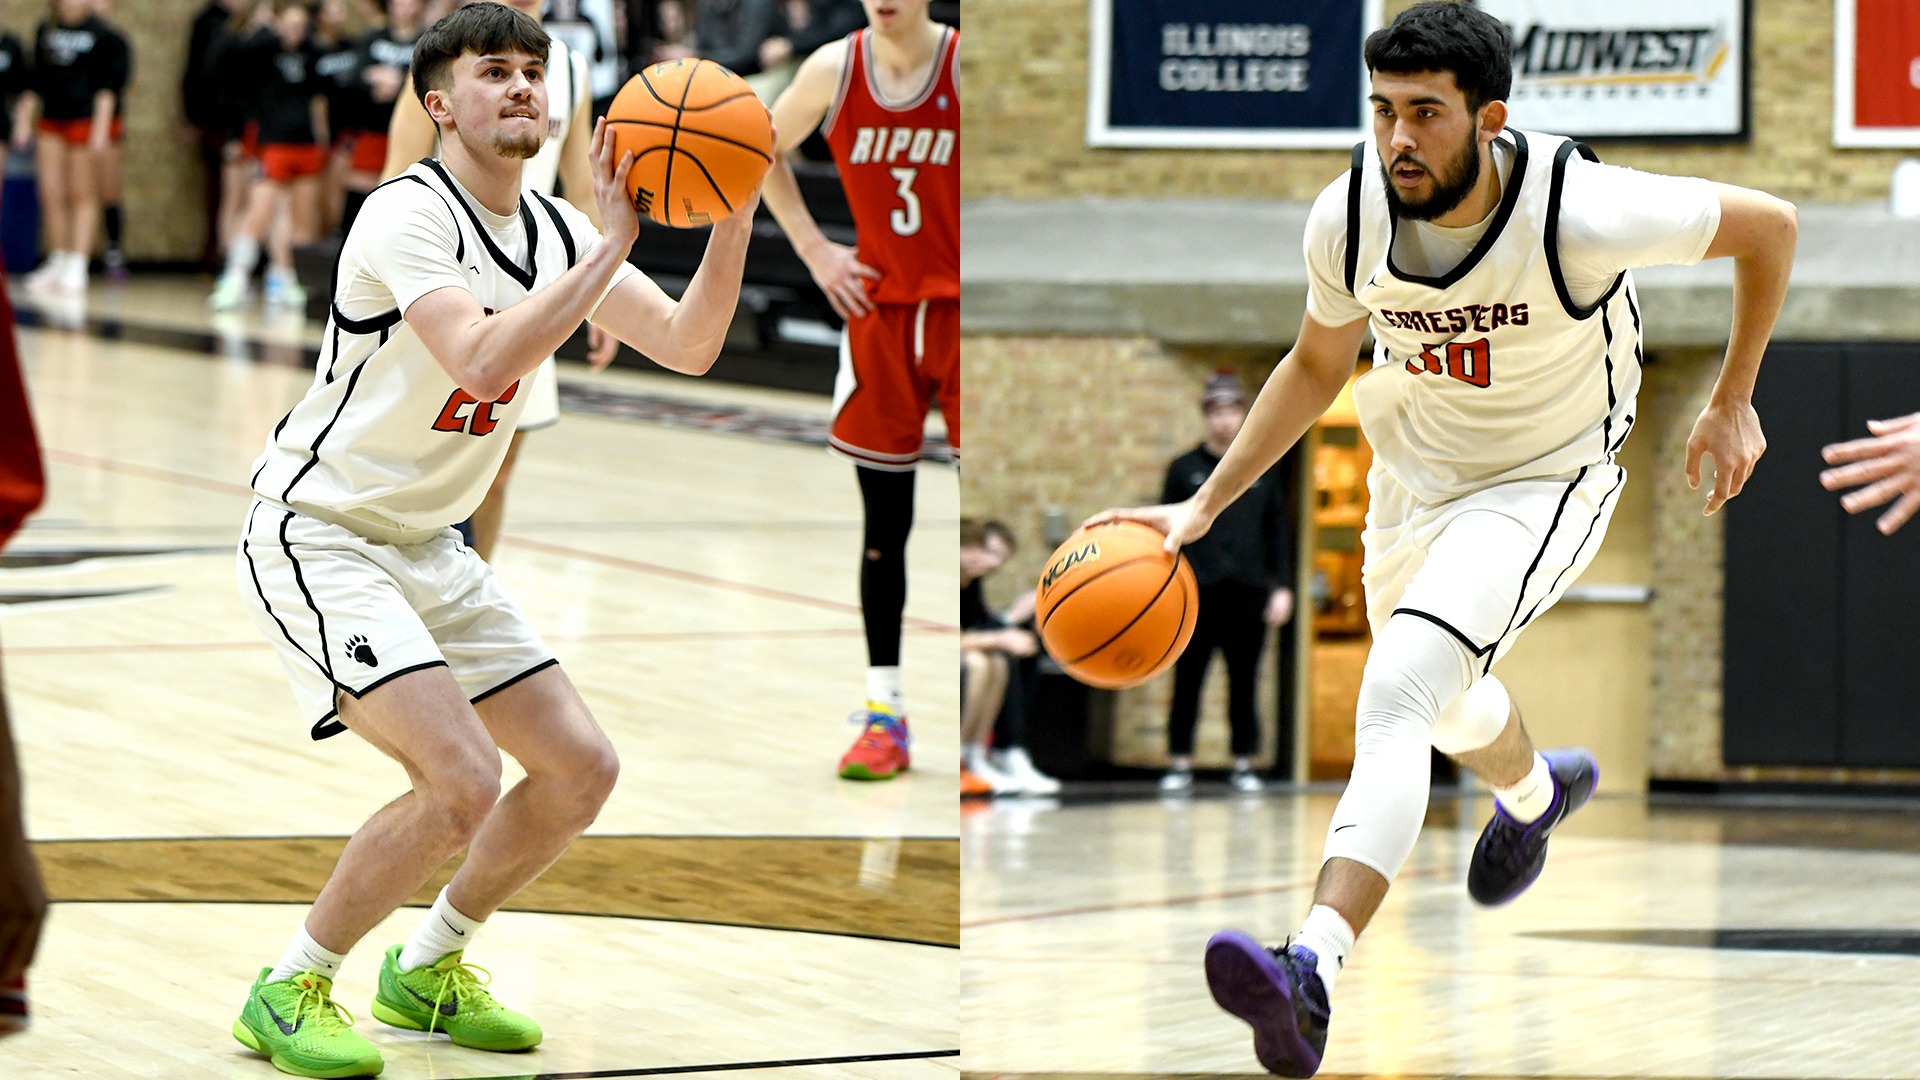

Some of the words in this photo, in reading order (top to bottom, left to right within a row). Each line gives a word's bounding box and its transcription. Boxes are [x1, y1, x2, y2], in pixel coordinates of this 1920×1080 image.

[1162, 23, 1310, 57] ILLINOIS
[1159, 57, 1310, 91] COLLEGE
[849, 126, 956, 166] RIPON
[889, 167, 922, 236] 3
[1041, 541, 1098, 592] NCAA
